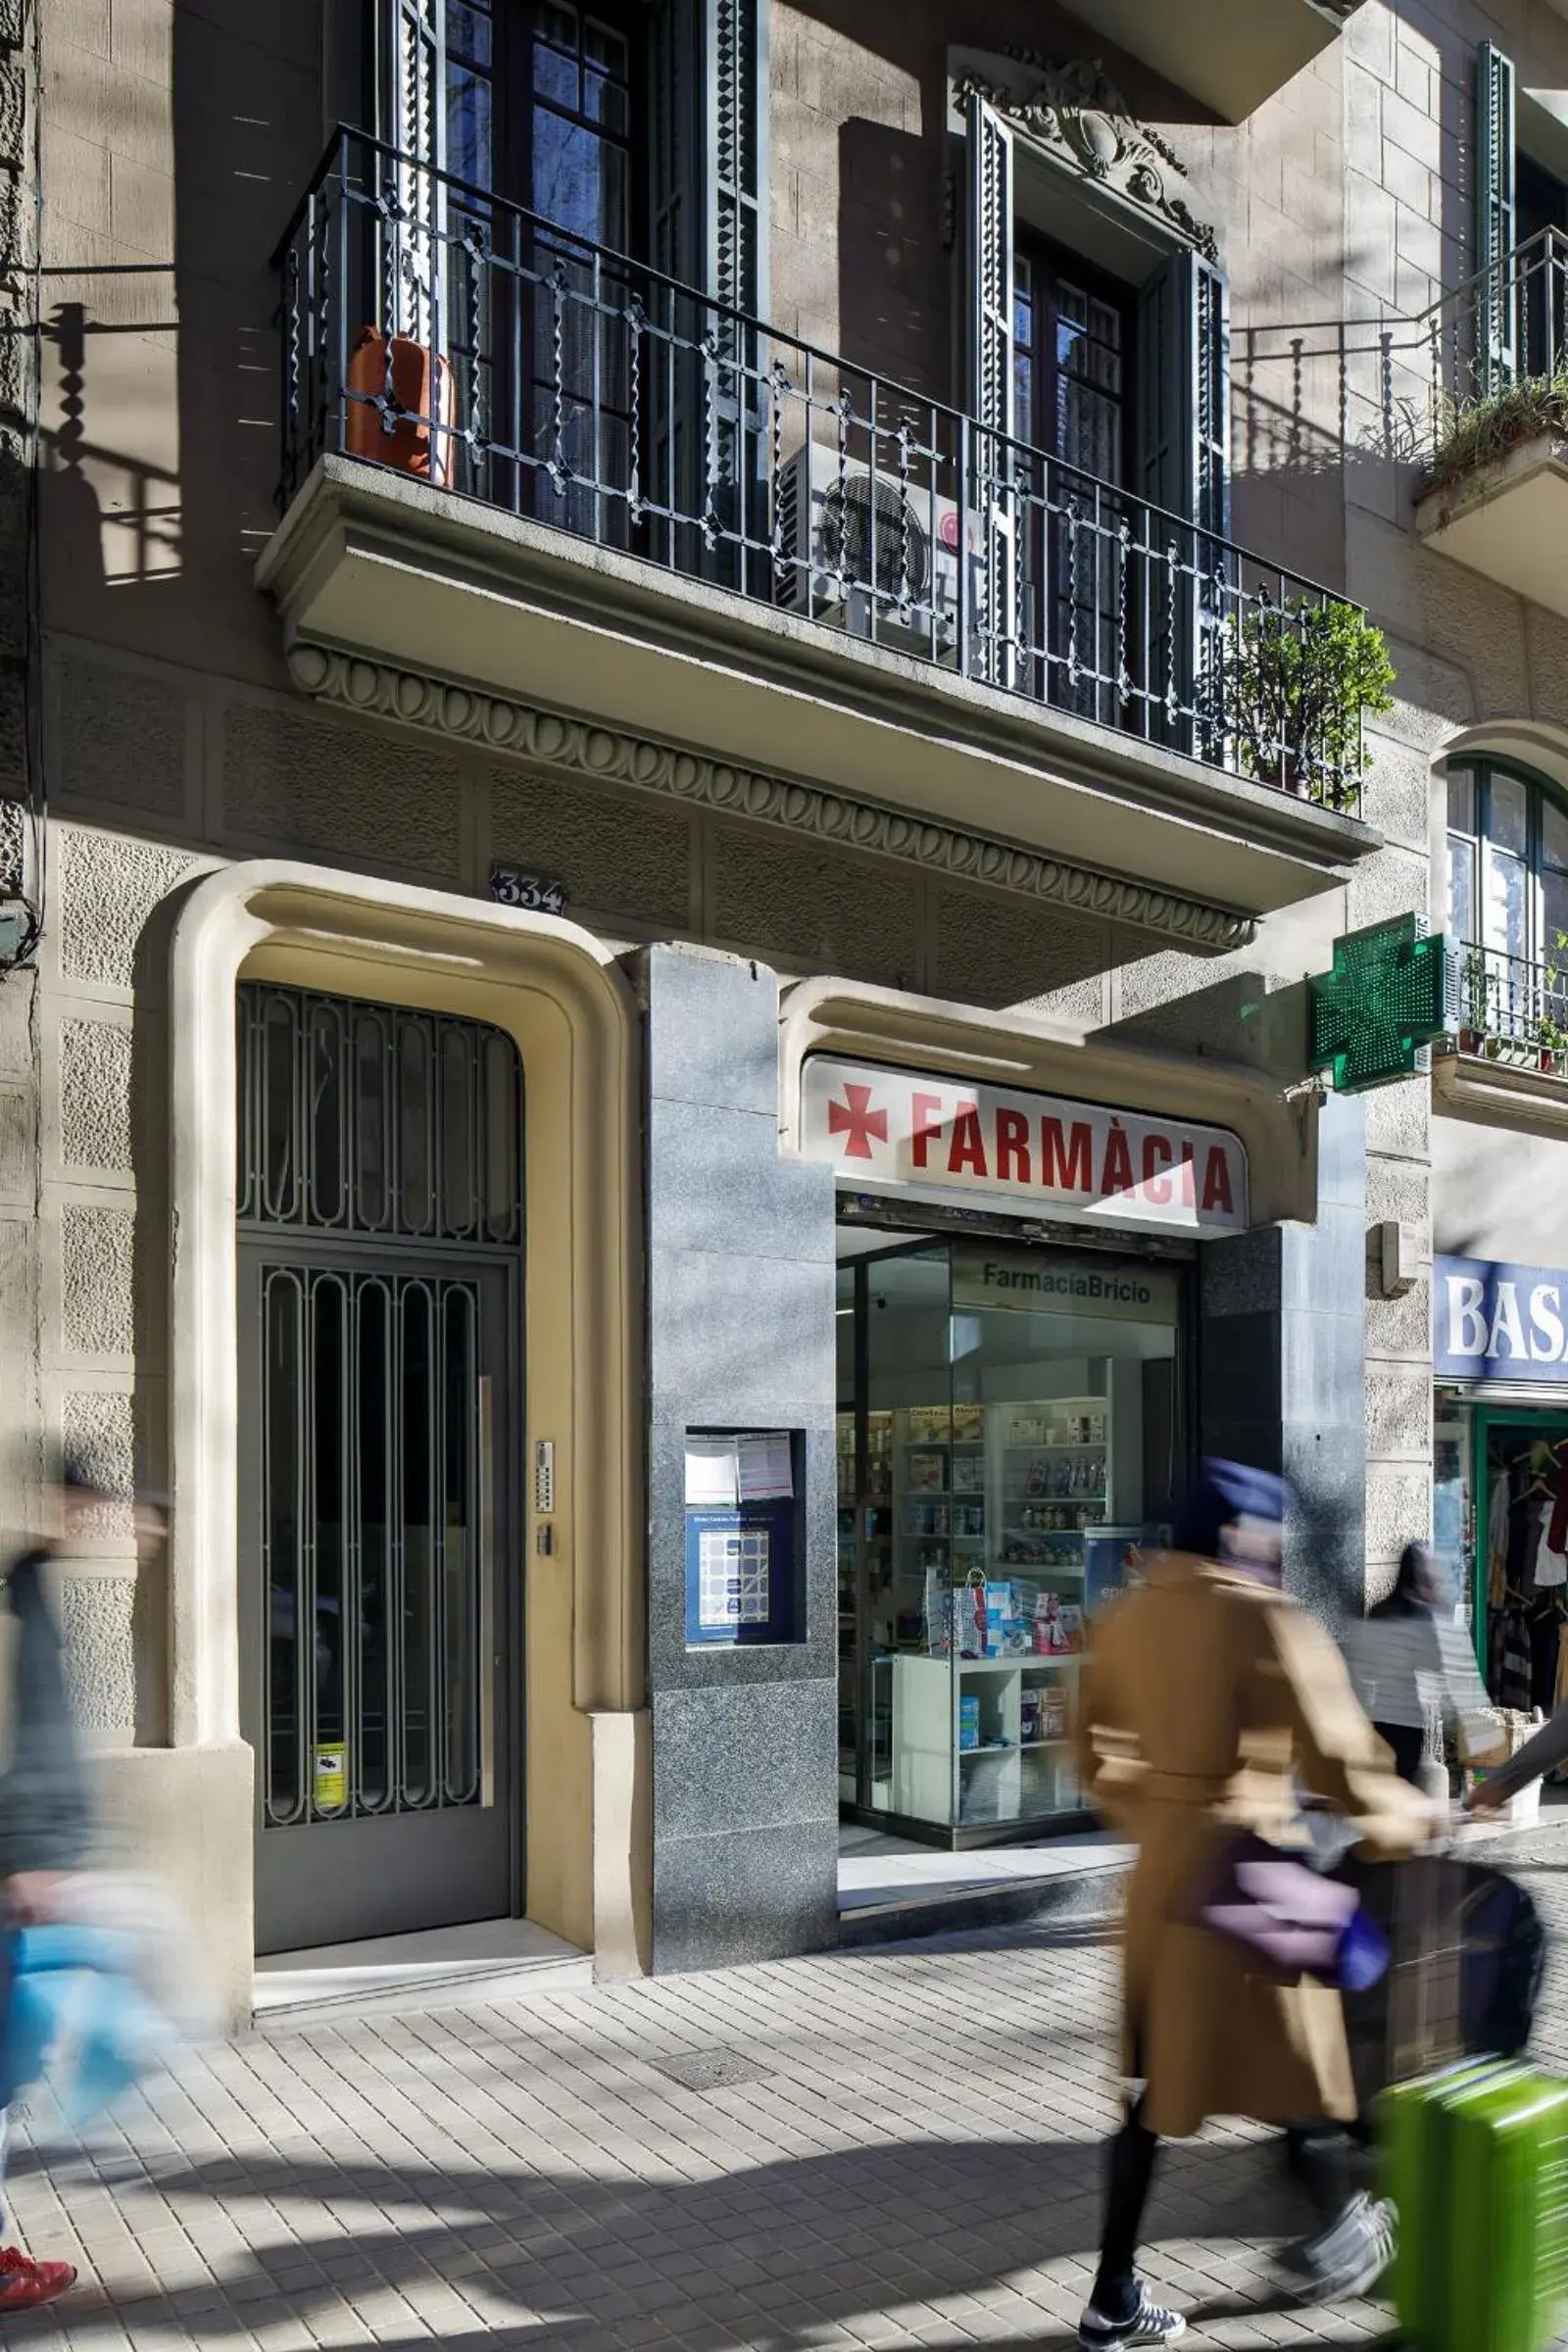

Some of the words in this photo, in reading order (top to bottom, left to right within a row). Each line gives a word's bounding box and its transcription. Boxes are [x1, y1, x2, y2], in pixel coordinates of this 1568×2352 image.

[498, 870, 563, 913] 334
[911, 1092, 1234, 1214] FARMÀCIA
[984, 1262, 1151, 1304] FarmaciaBricio
[1445, 1276, 1568, 1362] BAS
